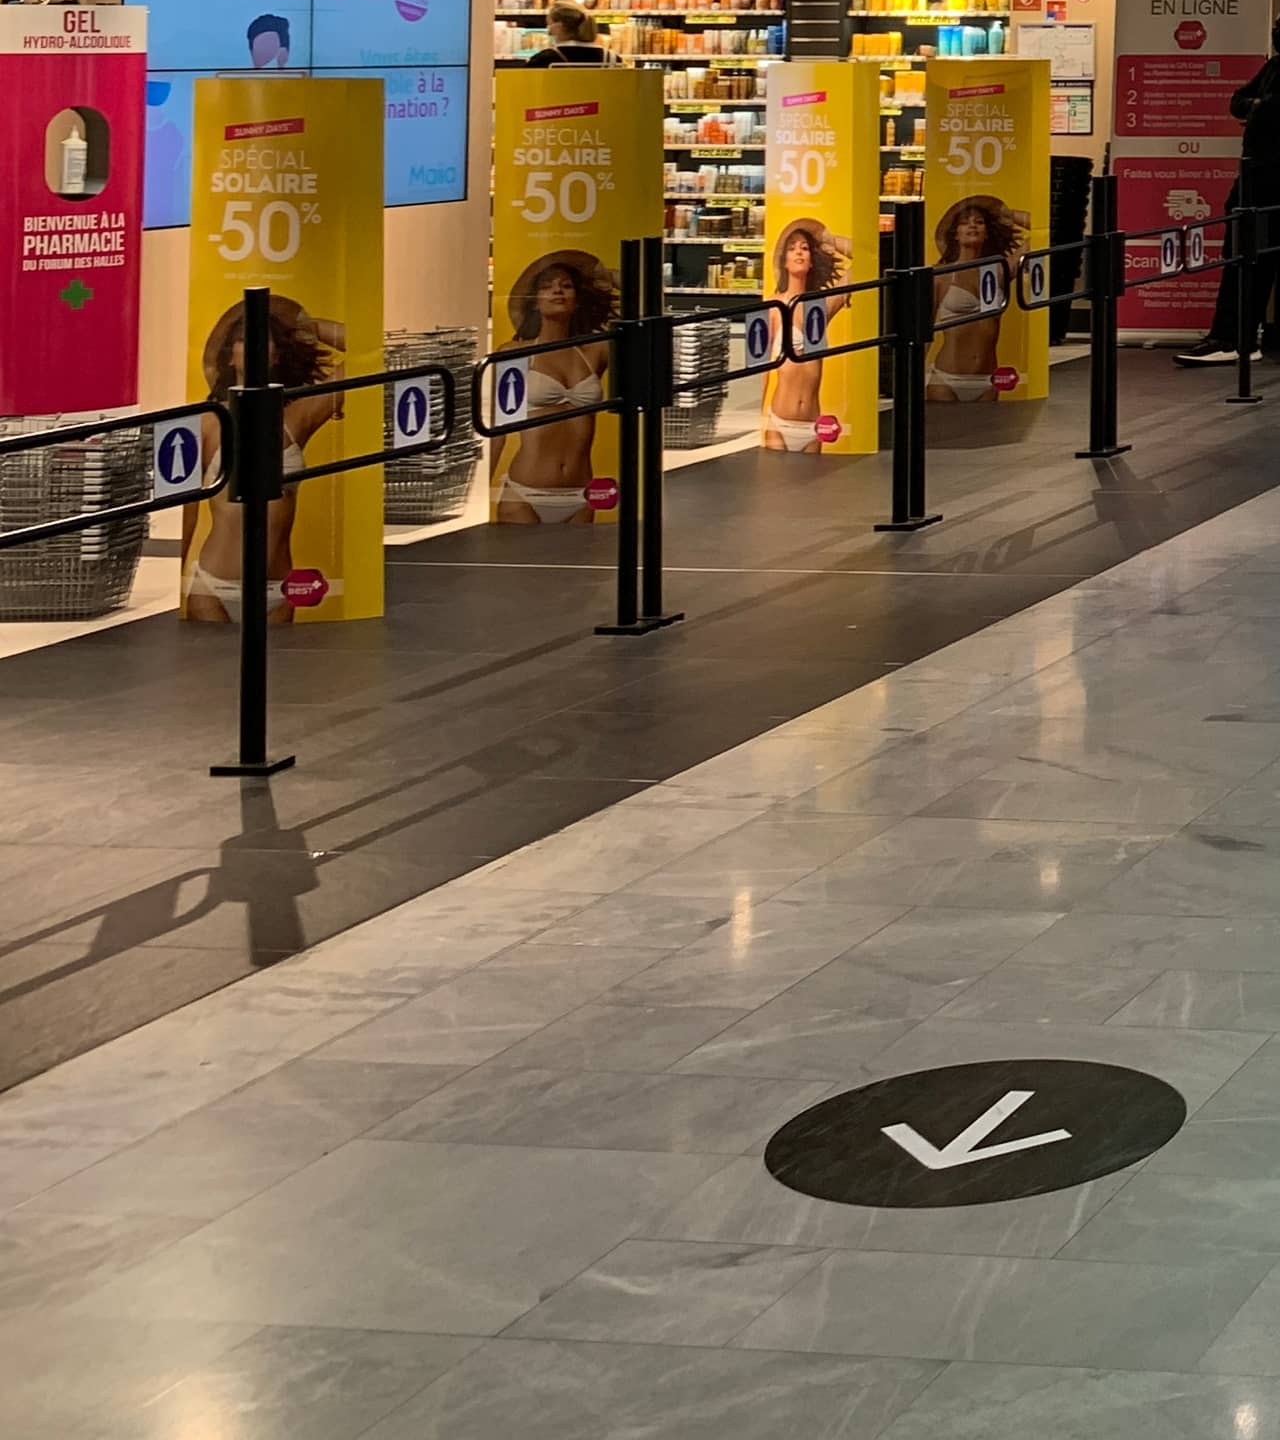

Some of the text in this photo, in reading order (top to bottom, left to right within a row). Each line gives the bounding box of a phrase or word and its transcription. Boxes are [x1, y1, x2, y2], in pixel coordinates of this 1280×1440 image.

[1151, 0, 1239, 15] EN LIGNE
[63, 10, 101, 33] GEL
[24, 36, 132, 49] HYDRO-ALCOOLIQUE
[418, 72, 426, 93] à
[431, 72, 444, 93] la
[1128, 67, 1135, 81] 1
[1127, 90, 1137, 105] 2
[940, 118, 1014, 132] SOLAIRE
[1126, 113, 1137, 128] 3
[522, 124, 606, 145] SPÉCIAL
[776, 130, 836, 145] SOLAIRE
[221, 144, 312, 170] SPÉCIAL
[513, 148, 611, 165] SOLAIRE
[938, 136, 1016, 175] -50%
[1178, 142, 1200, 153] OU
[774, 150, 838, 194] -50%
[211, 172, 318, 194] SOLAIRE
[511, 171, 615, 223] -50%
[24, 211, 125, 232] BIENVENUE À LA
[208, 200, 321, 262] -50%
[23, 231, 125, 256] PHARMACIE
[22, 254, 125, 271] DU FORUM DES HALLES
